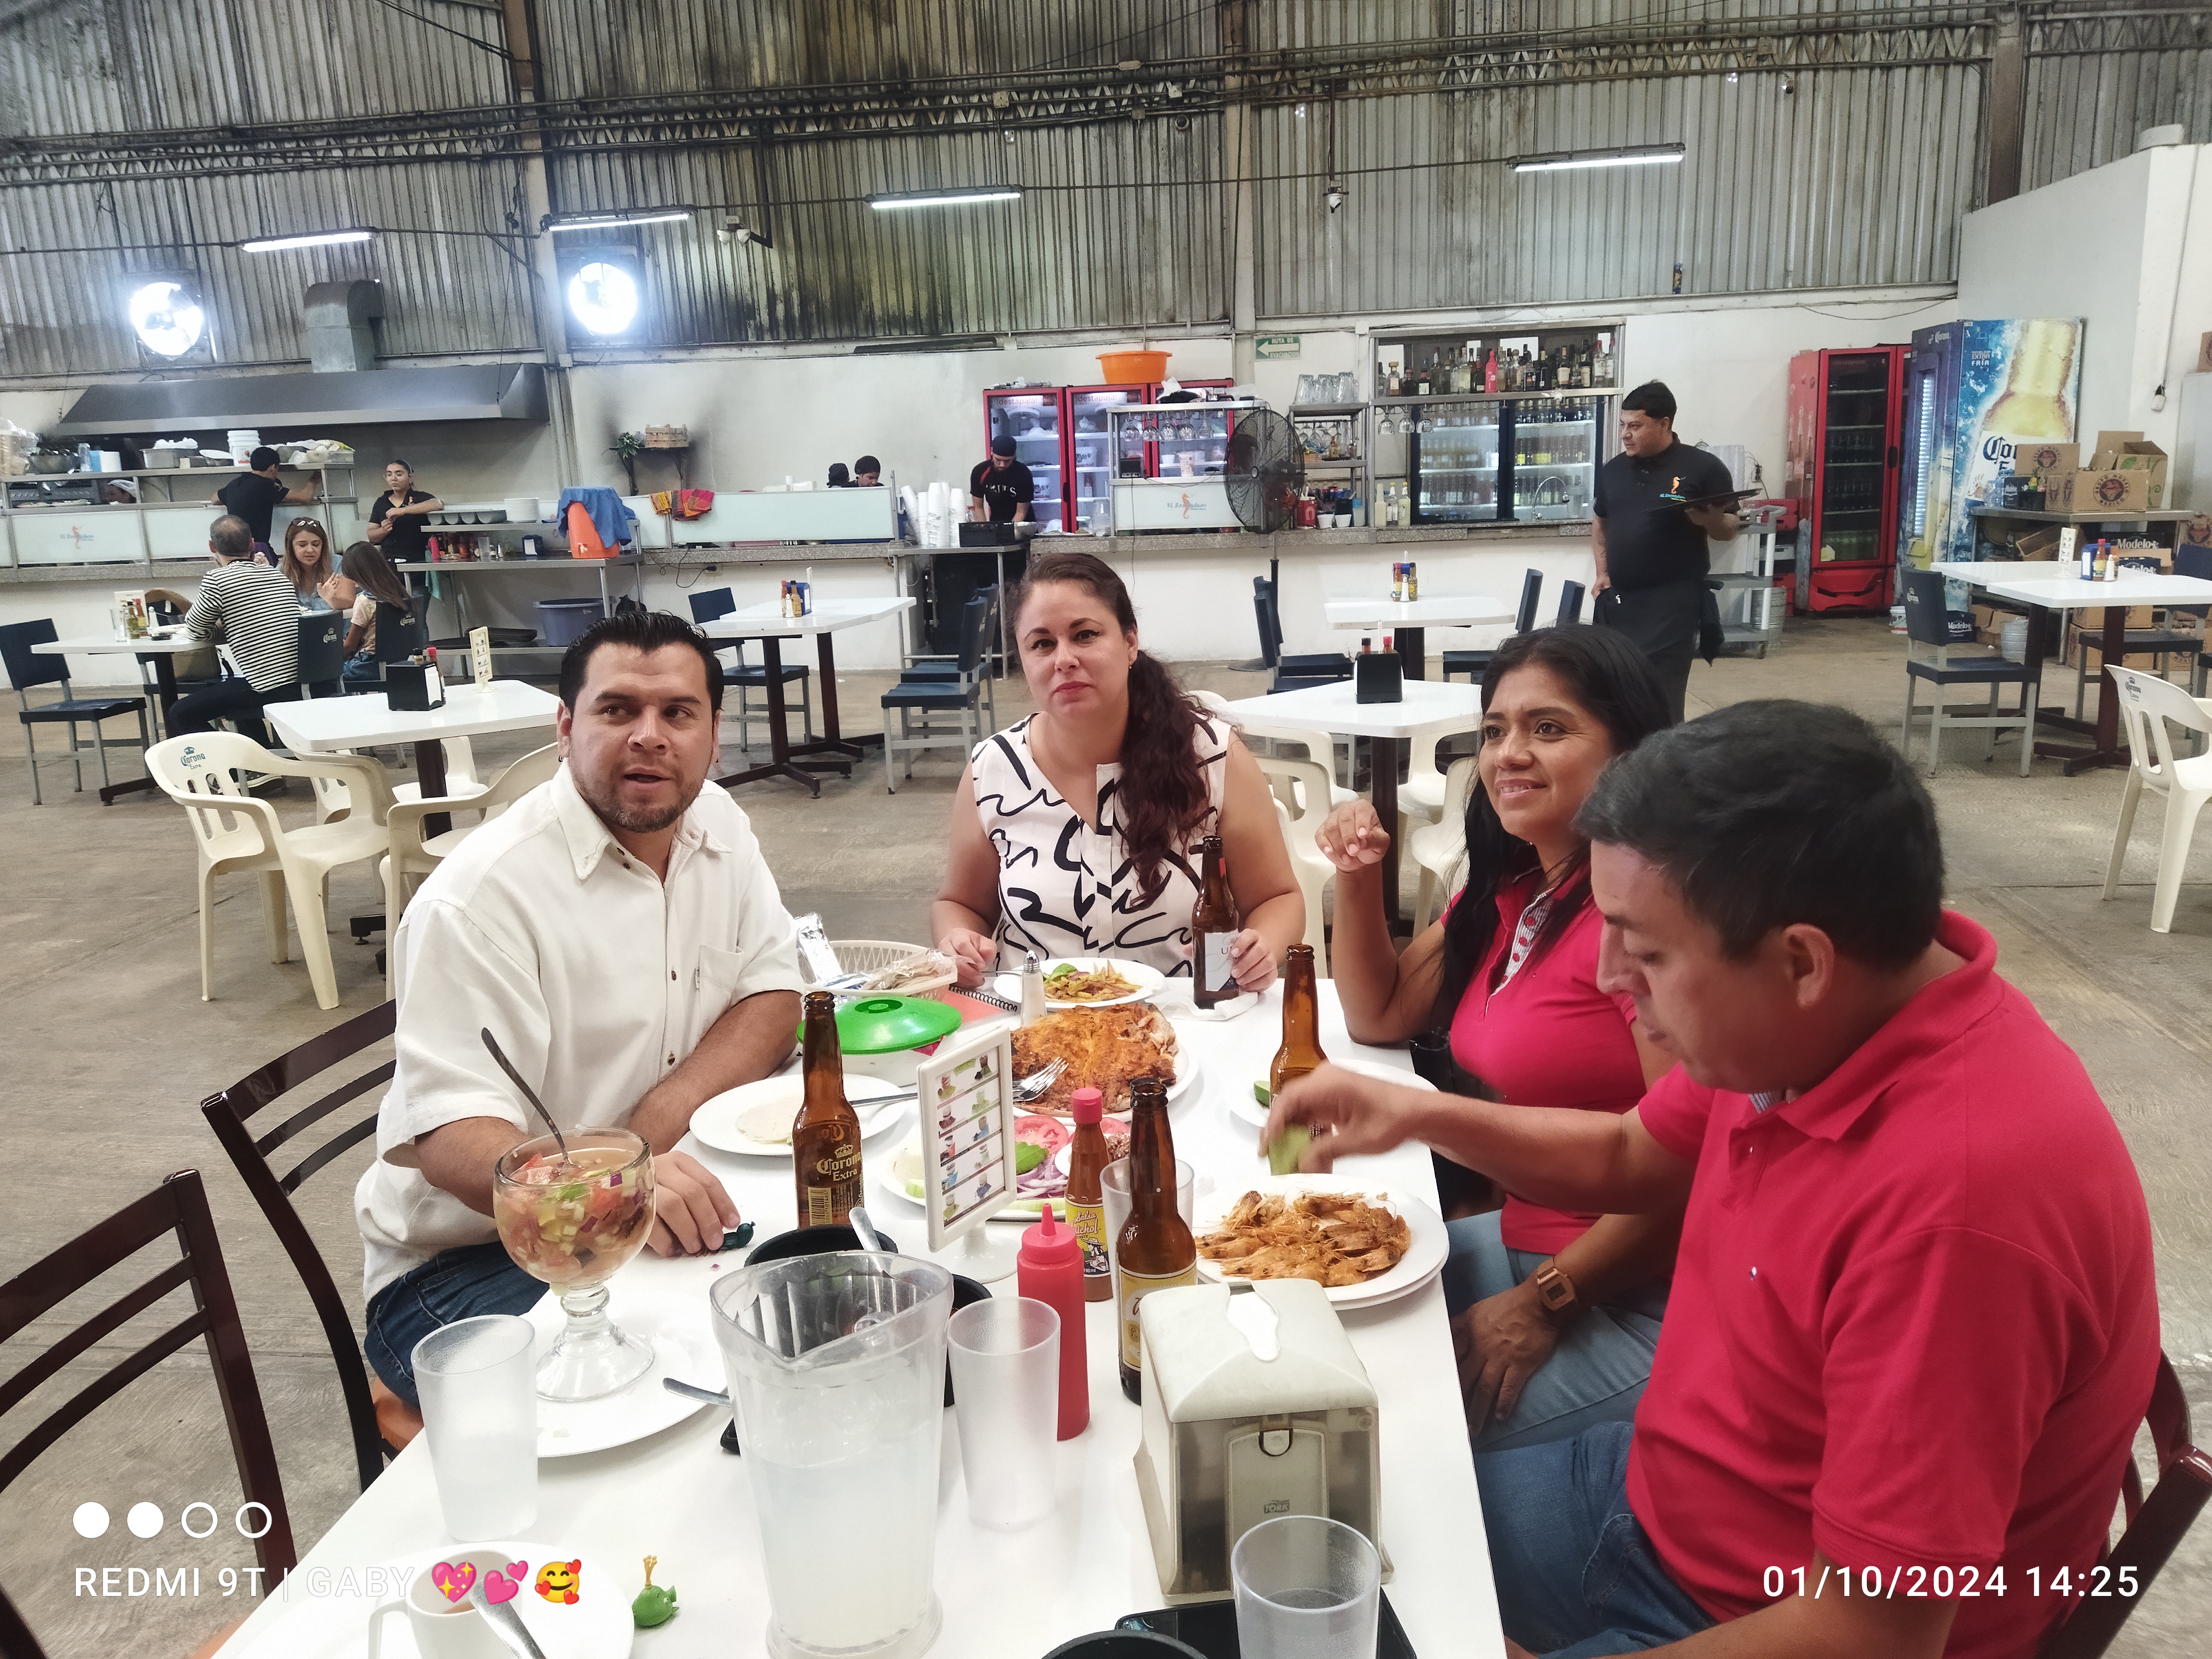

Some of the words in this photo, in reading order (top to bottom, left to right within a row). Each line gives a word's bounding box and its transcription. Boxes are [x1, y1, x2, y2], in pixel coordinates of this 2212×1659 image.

[2117, 538, 2152, 549] Modelo
[180, 753, 206, 766] Corona
[816, 1151, 863, 1176] Corona
[832, 1168, 857, 1182] Extra
[1074, 1210, 1097, 1223] Salsa
[1068, 1218, 1099, 1234] uichol
[1264, 1503, 1290, 1514] TORK
